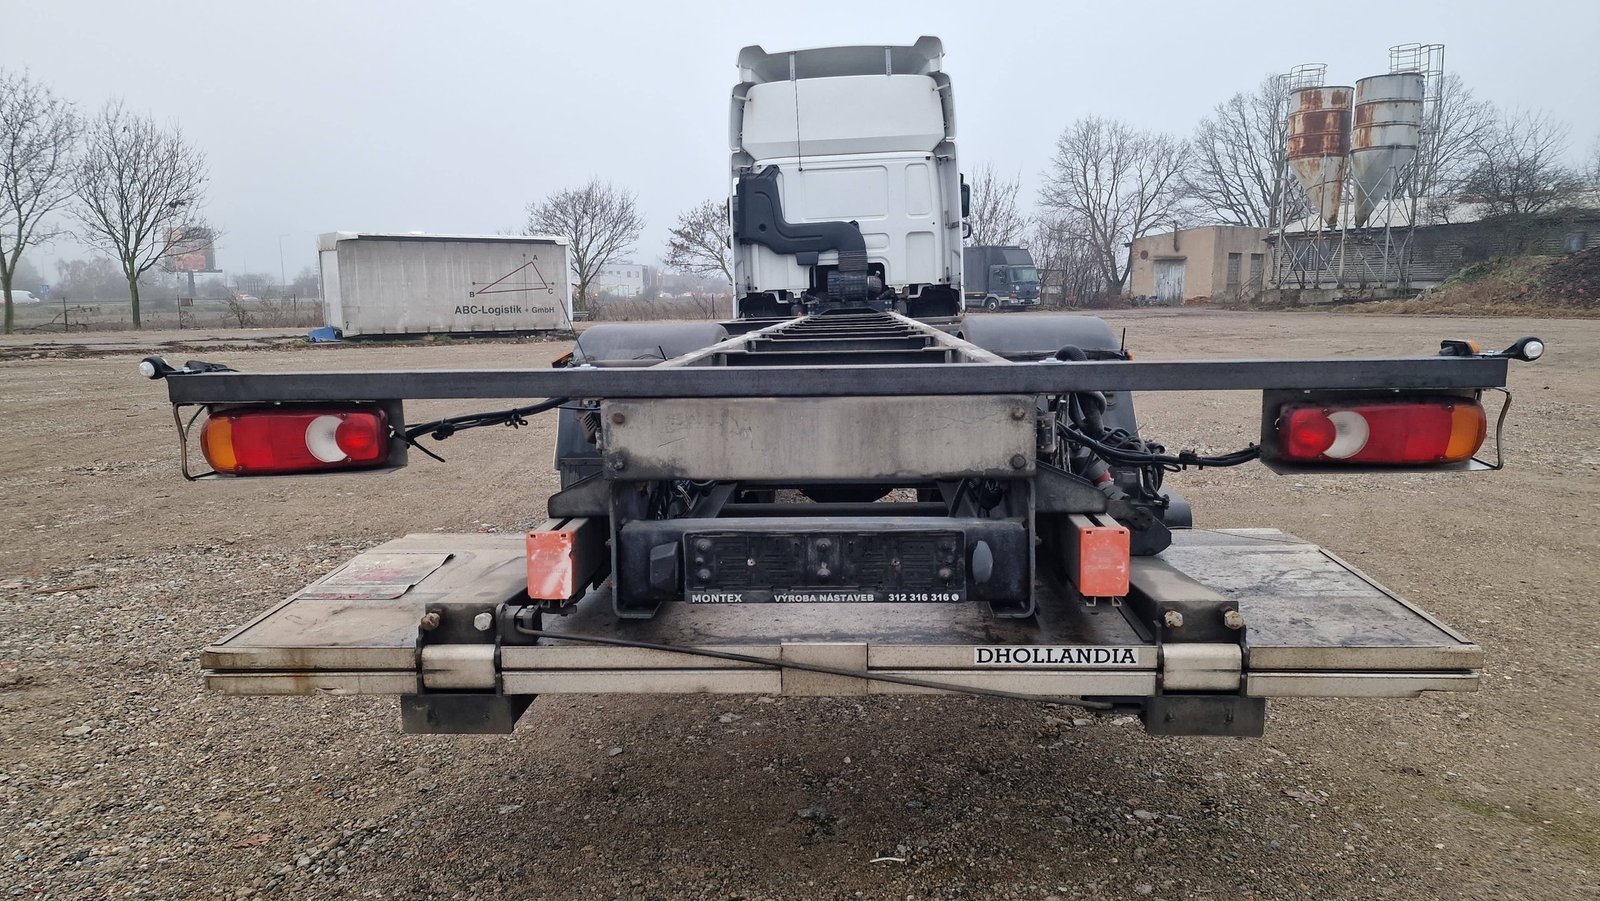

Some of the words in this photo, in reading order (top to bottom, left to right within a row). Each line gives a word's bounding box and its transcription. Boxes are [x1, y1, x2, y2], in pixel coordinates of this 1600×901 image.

[454, 305, 522, 316] ABC-Logistik
[531, 306, 555, 314] GmbH
[691, 593, 743, 603] MONTEX
[773, 593, 817, 603] VÝROBA
[819, 592, 875, 602] NÁSTAVEB
[888, 593, 907, 602] 312
[909, 593, 928, 602] 316
[930, 593, 950, 602] 316
[976, 648, 1137, 664] DHOLLANDIA
